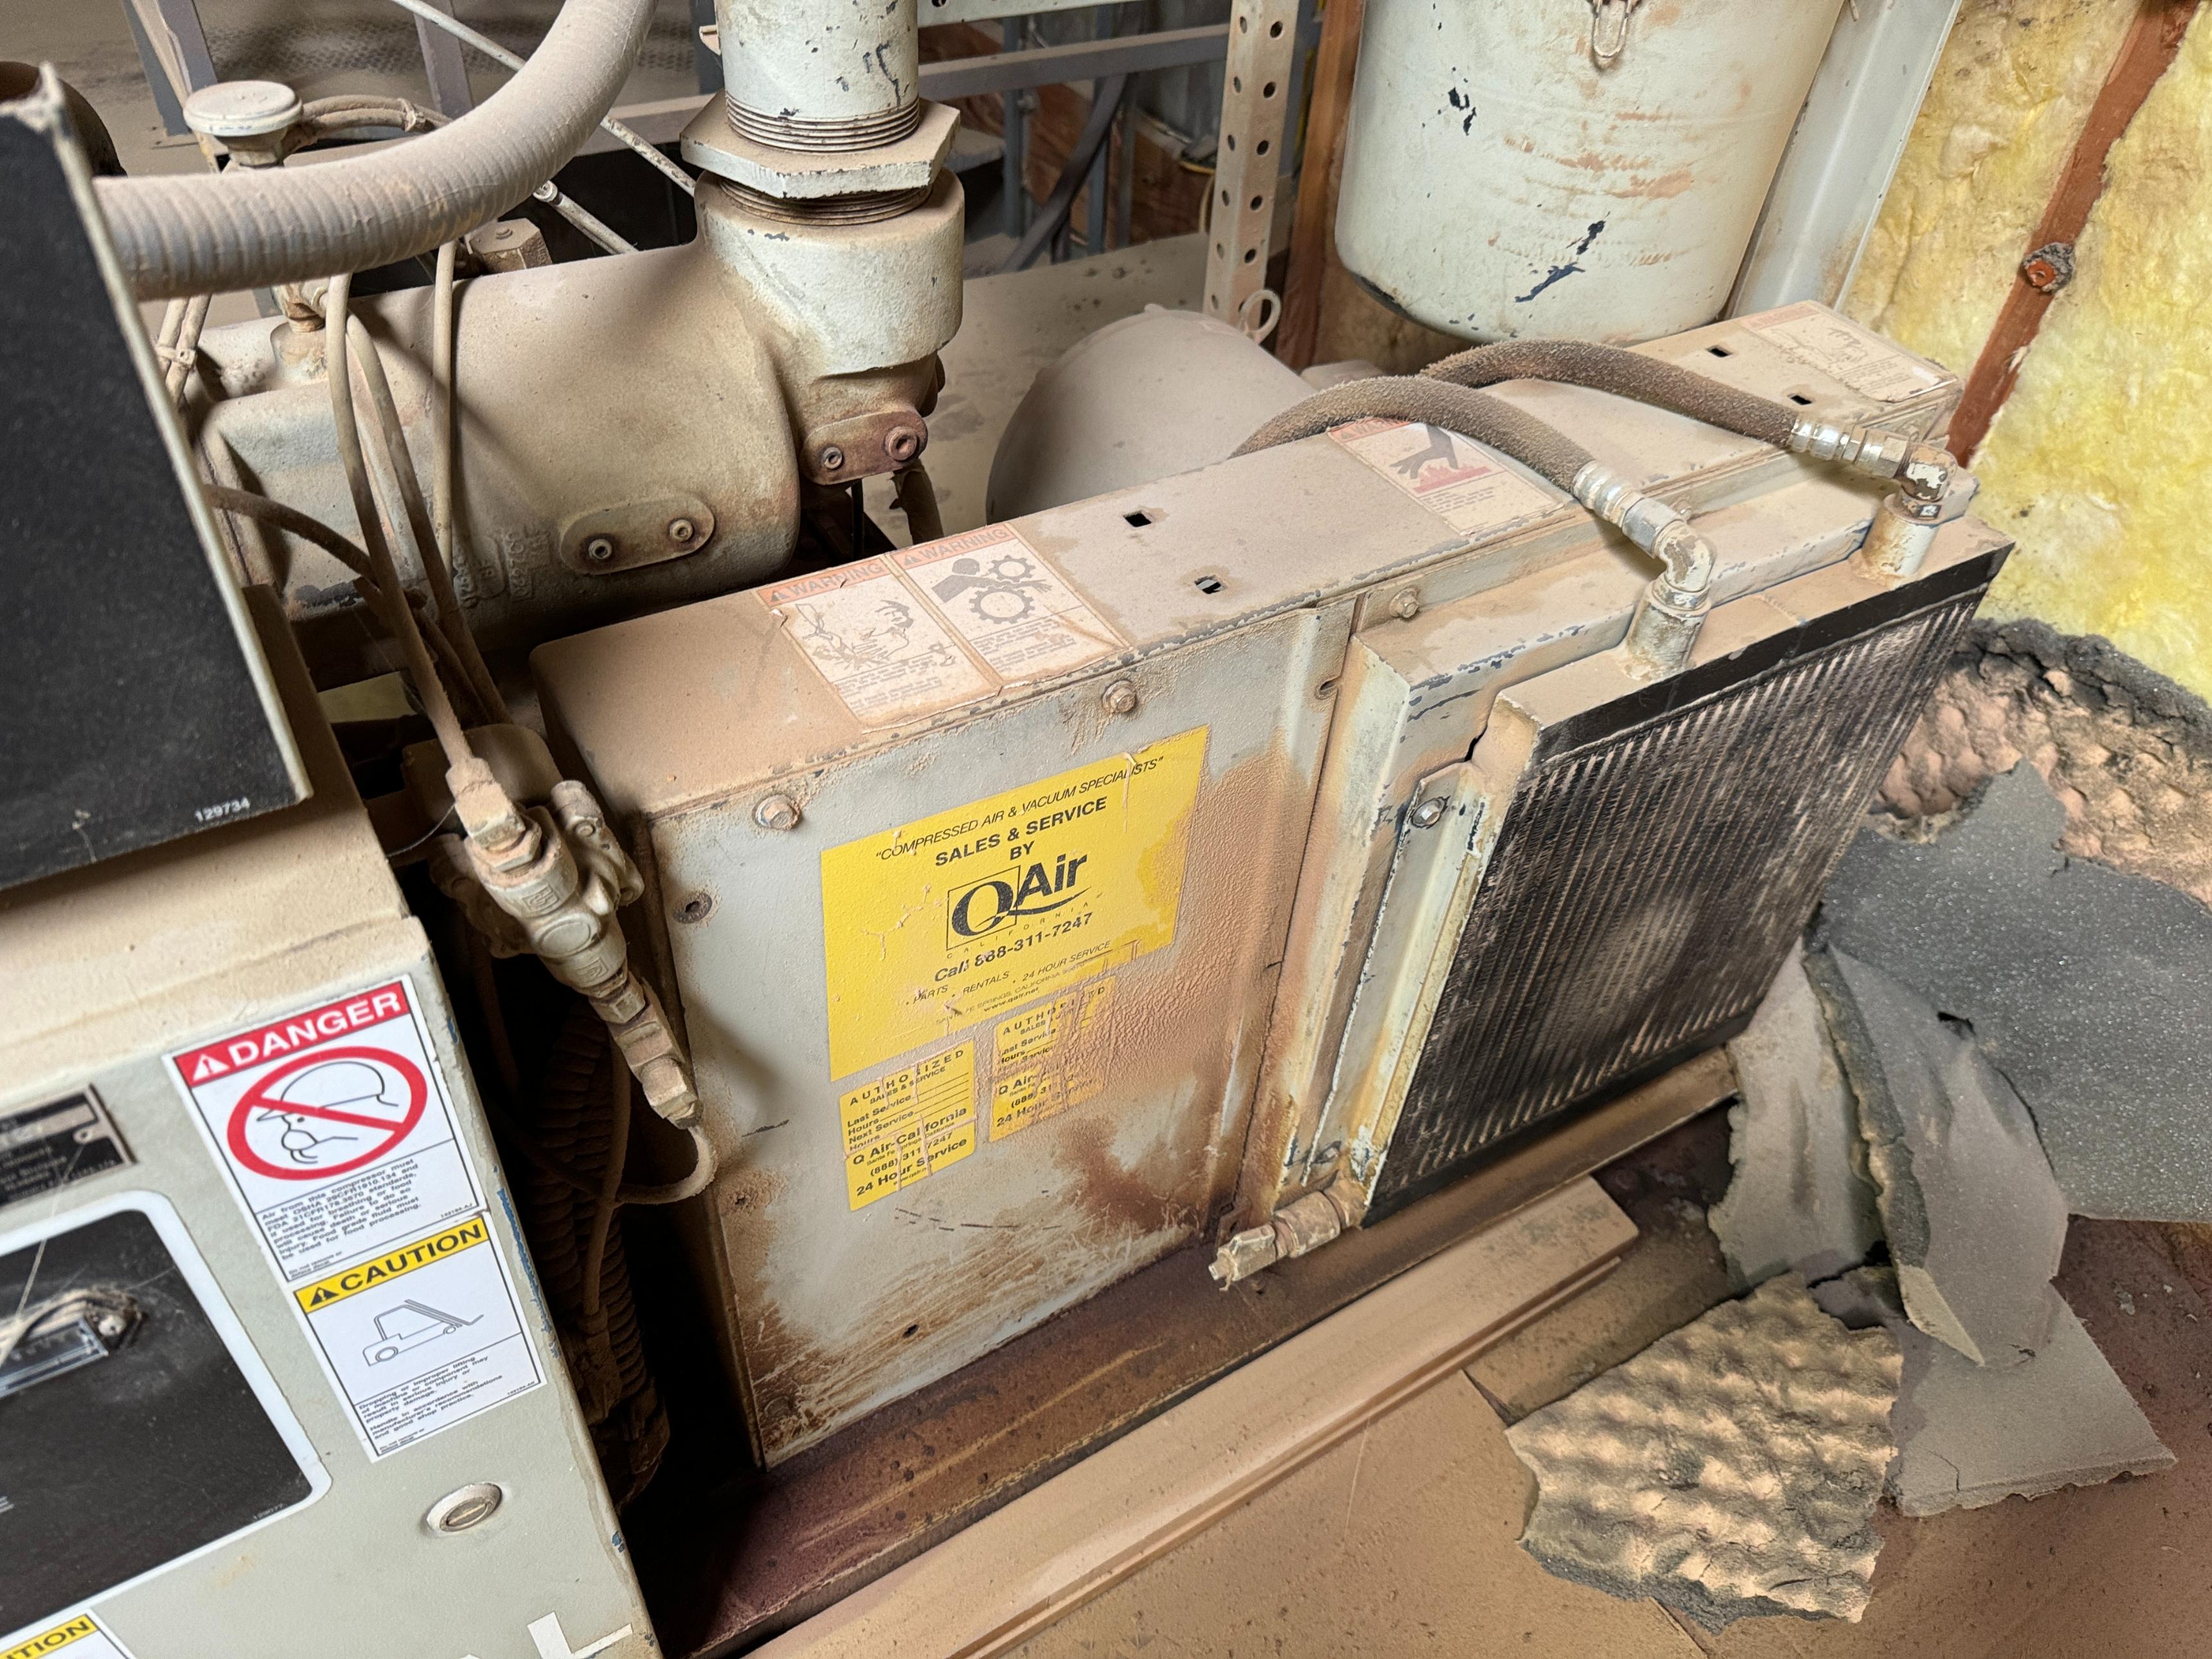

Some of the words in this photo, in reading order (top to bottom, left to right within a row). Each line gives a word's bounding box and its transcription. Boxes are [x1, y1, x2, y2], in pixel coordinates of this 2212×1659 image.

[919, 528, 1010, 559] WARNING
[981, 810, 1004, 828] AIR
[1008, 806, 1017, 817] &
[1022, 786, 1076, 812] VACUUM
[936, 833, 1000, 866] SALES
[1008, 828, 1019, 841] &
[1026, 797, 1107, 835] SERVICE
[1010, 841, 1035, 860] BY
[963, 971, 1010, 993] RENTALS
[1022, 970, 1035, 982] 24
[1038, 958, 1067, 975] HOUR
[1069, 941, 1111, 963] SERVICE
[227, 991, 402, 1067] DANGER
[999, 1084, 1008, 1094] Q
[848, 1112, 870, 1128] Last
[848, 1119, 879, 1136] Hours
[849, 1128, 872, 1144] Next
[875, 1111, 914, 1131] Service
[997, 1114, 1012, 1126] 24
[853, 1155, 864, 1165] Q
[857, 1183, 873, 1196] 24
[878, 1164, 913, 1185] Hour
[916, 1139, 967, 1166] Service
[871, 1160, 898, 1176] (888)
[280, 1202, 303, 1212] from
[308, 1193, 326, 1203] this
[332, 1169, 386, 1194] compressor
[391, 1159, 414, 1171] must
[293, 1202, 321, 1214] OSHA
[401, 1164, 418, 1173] and
[281, 1221, 306, 1232] used
[328, 1195, 373, 1216] breathing
[391, 1180, 411, 1191] food
[297, 1227, 325, 1240] cause
[330, 1216, 355, 1227] death
[375, 1195, 409, 1211] serious
[312, 1229, 337, 1241] Food
[371, 1207, 392, 1218] fluid
[396, 1196, 419, 1209] must
[333, 1205, 365, 1220] Failure
[298, 1241, 321, 1253] used
[343, 1225, 365, 1236] food
[340, 1223, 482, 1291] CAUTION
[424, 1365, 468, 1387] component
[472, 1356, 488, 1366] may
[359, 1392, 397, 1410] Dropping
[402, 1387, 432, 1401] serious
[414, 1390, 458, 1412] accordance
[461, 1381, 478, 1390] with
[434, 1375, 503, 1407] recommendations
[366, 1406, 400, 1424] property
